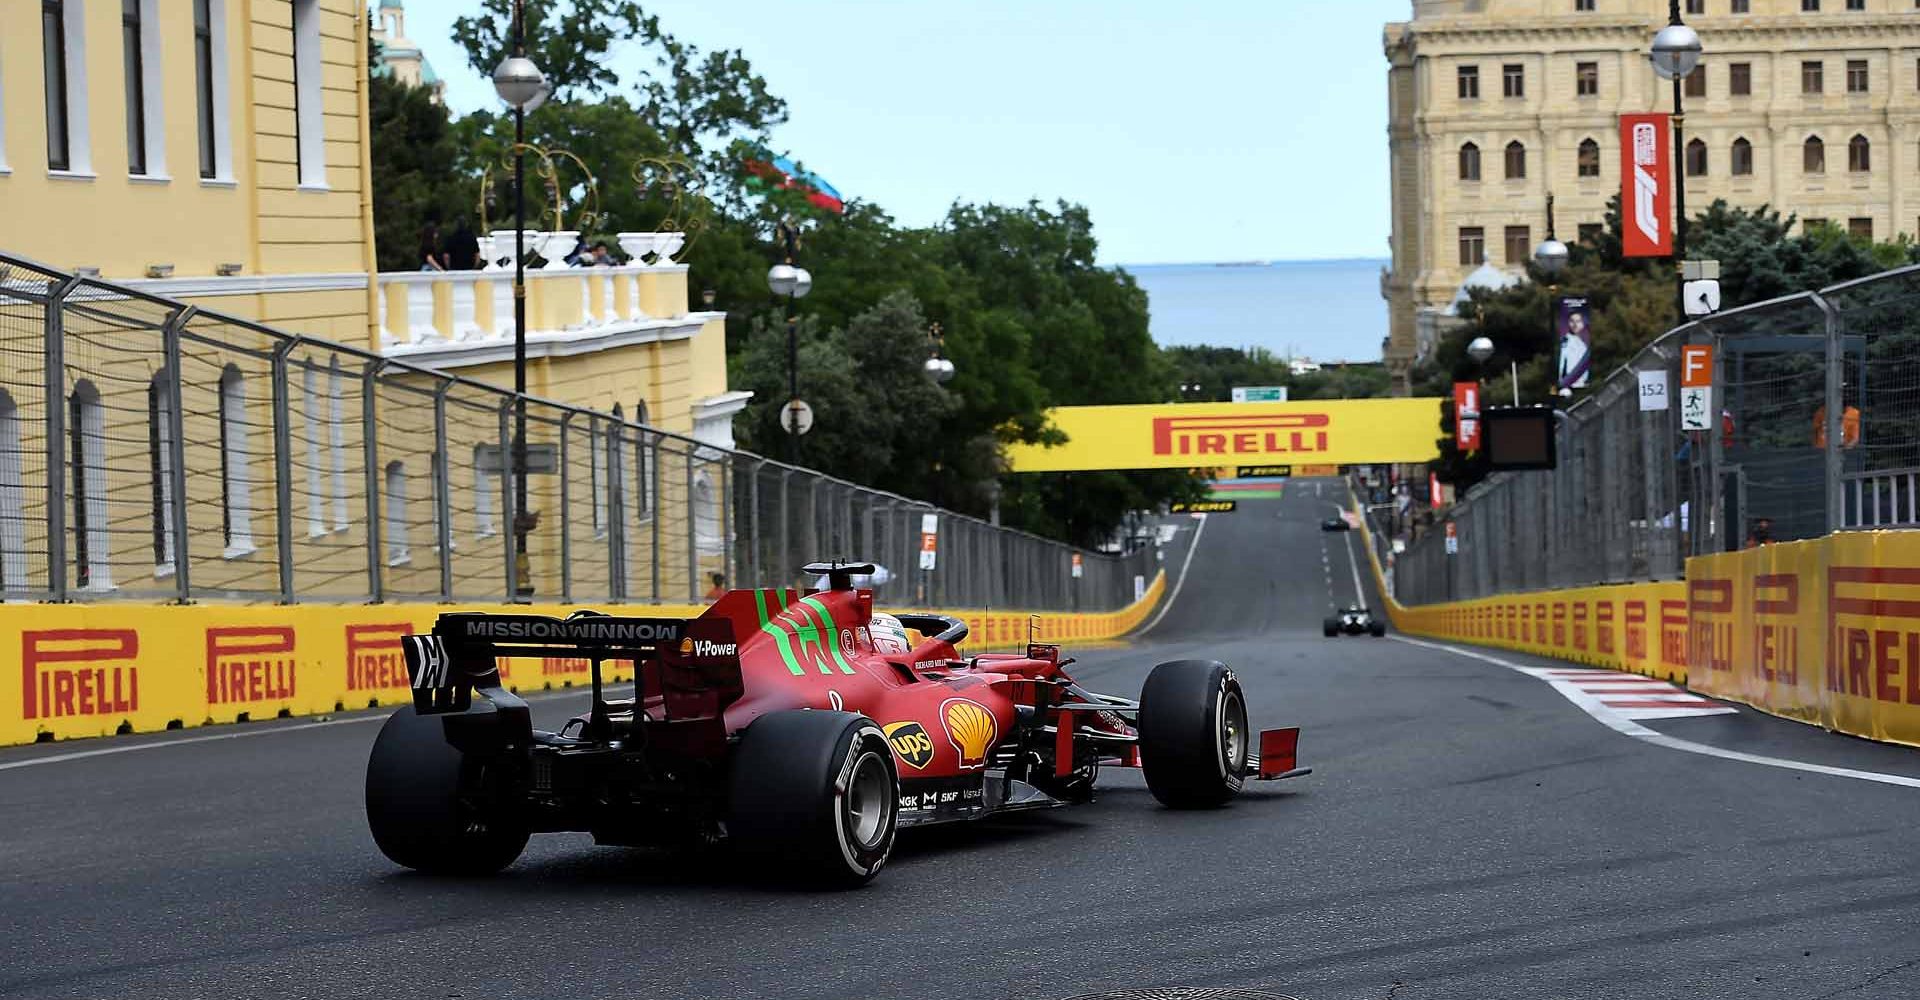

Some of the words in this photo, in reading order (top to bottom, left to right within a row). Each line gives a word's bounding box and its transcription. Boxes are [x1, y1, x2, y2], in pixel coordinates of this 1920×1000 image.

[1686, 351, 1706, 382] F
[1153, 414, 1329, 455] PIRELLI
[206, 626, 296, 704] PIRELLI
[345, 623, 414, 691] PIRELL
[695, 641, 737, 657] V-Power
[22, 629, 138, 719] PIRELLI
[891, 732, 931, 761] ups
[899, 796, 918, 806] NGK
[941, 792, 958, 803] SKF
